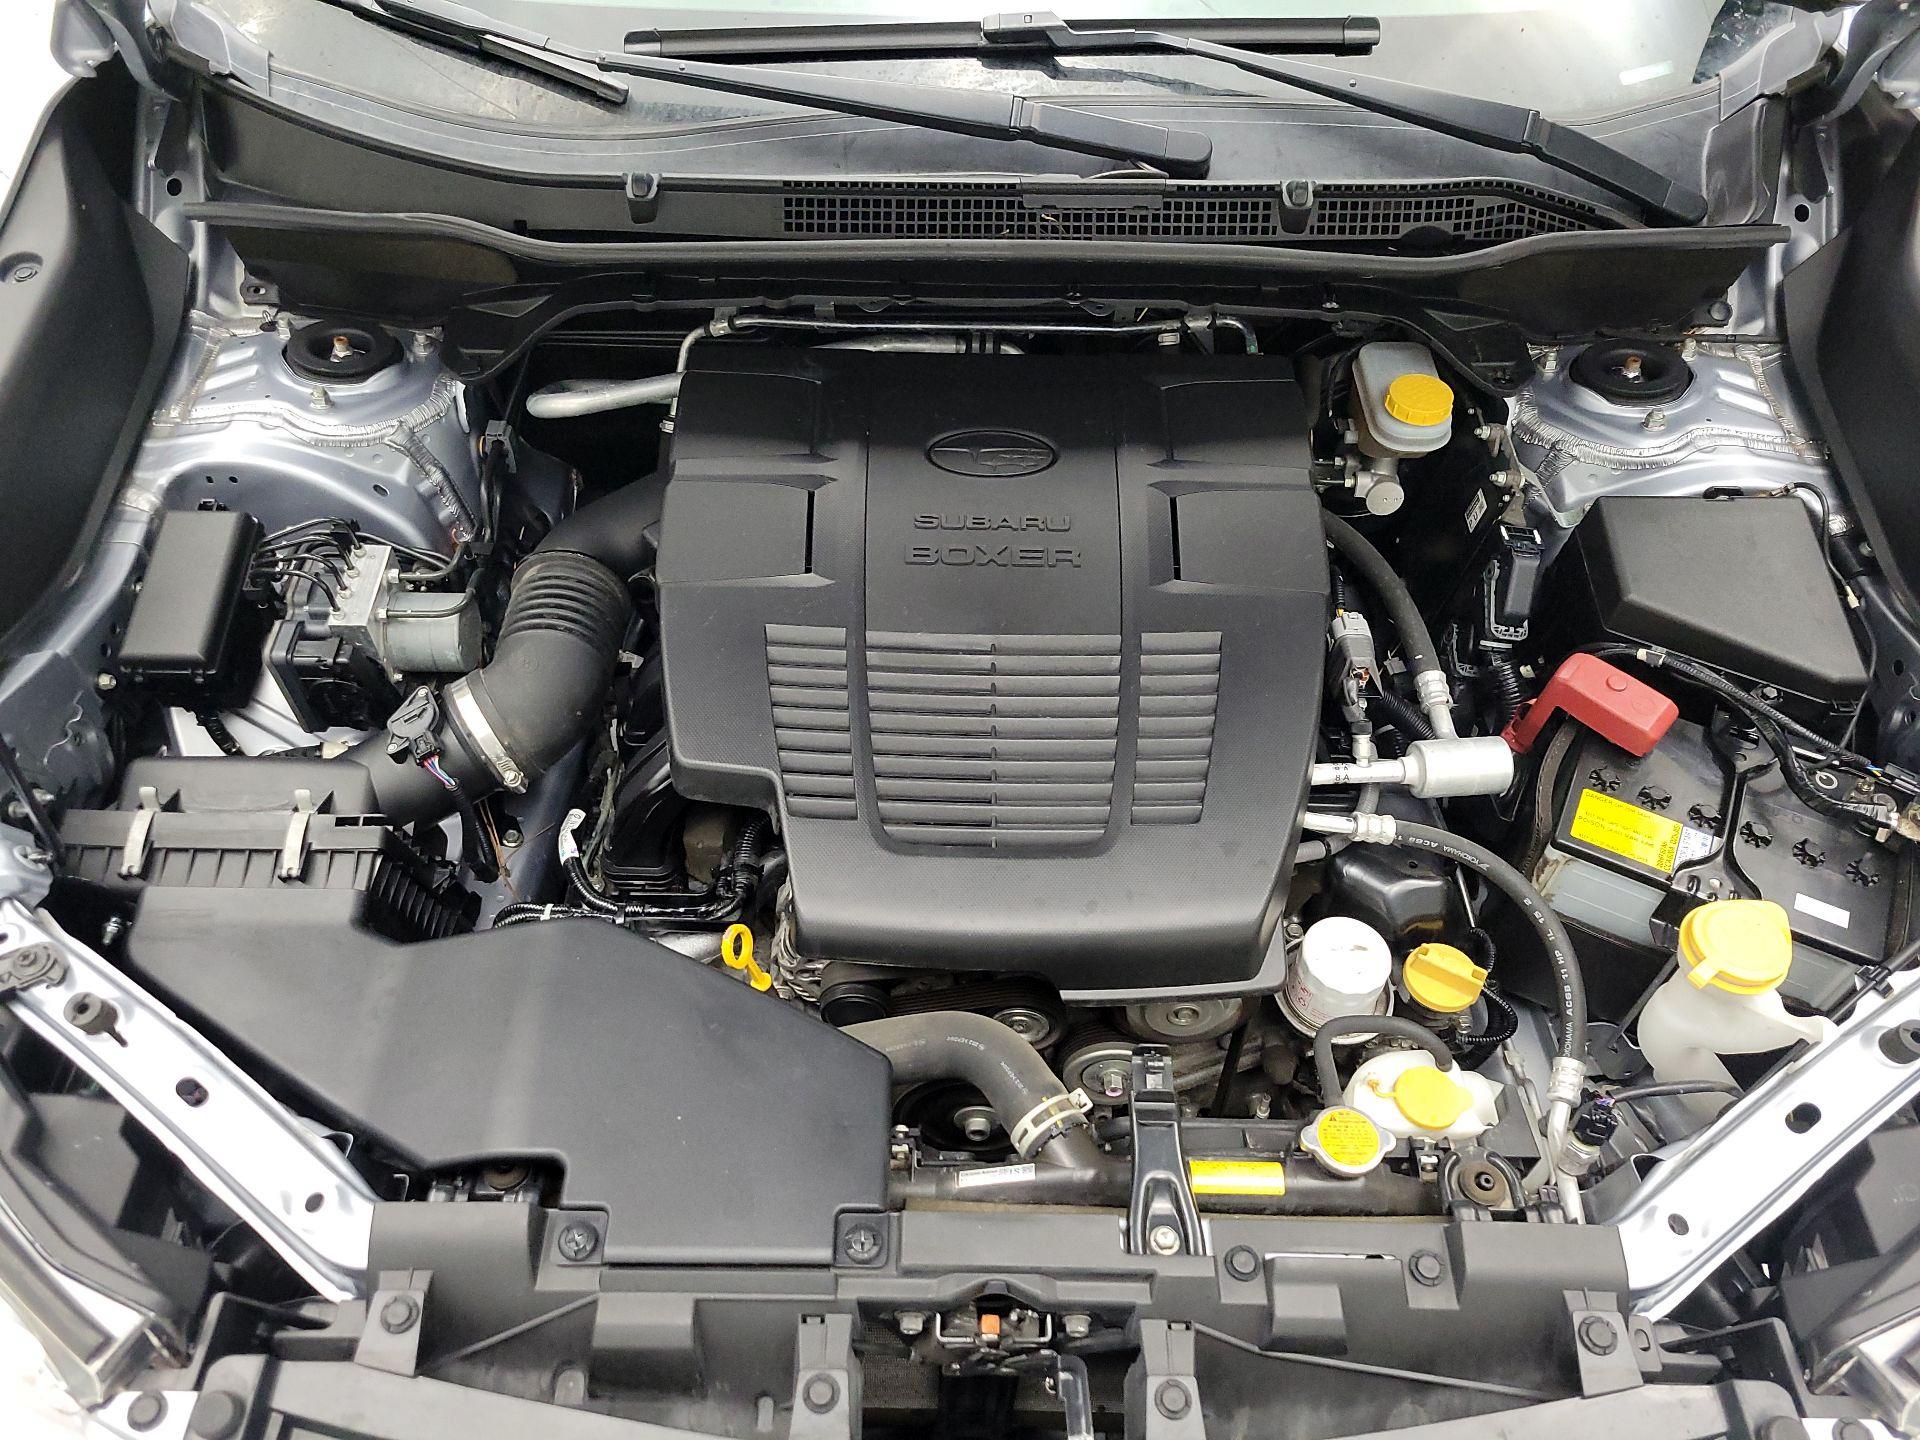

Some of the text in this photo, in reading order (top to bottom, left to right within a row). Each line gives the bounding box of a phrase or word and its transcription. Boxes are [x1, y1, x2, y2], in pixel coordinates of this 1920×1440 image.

[913, 512, 1071, 532] SUBARU
[904, 544, 1082, 568] BOXER
[1443, 845, 1480, 865] YOKOHAMA
[1554, 950, 1565, 965] HP
[1563, 1021, 1574, 1057] OKOHAMA
